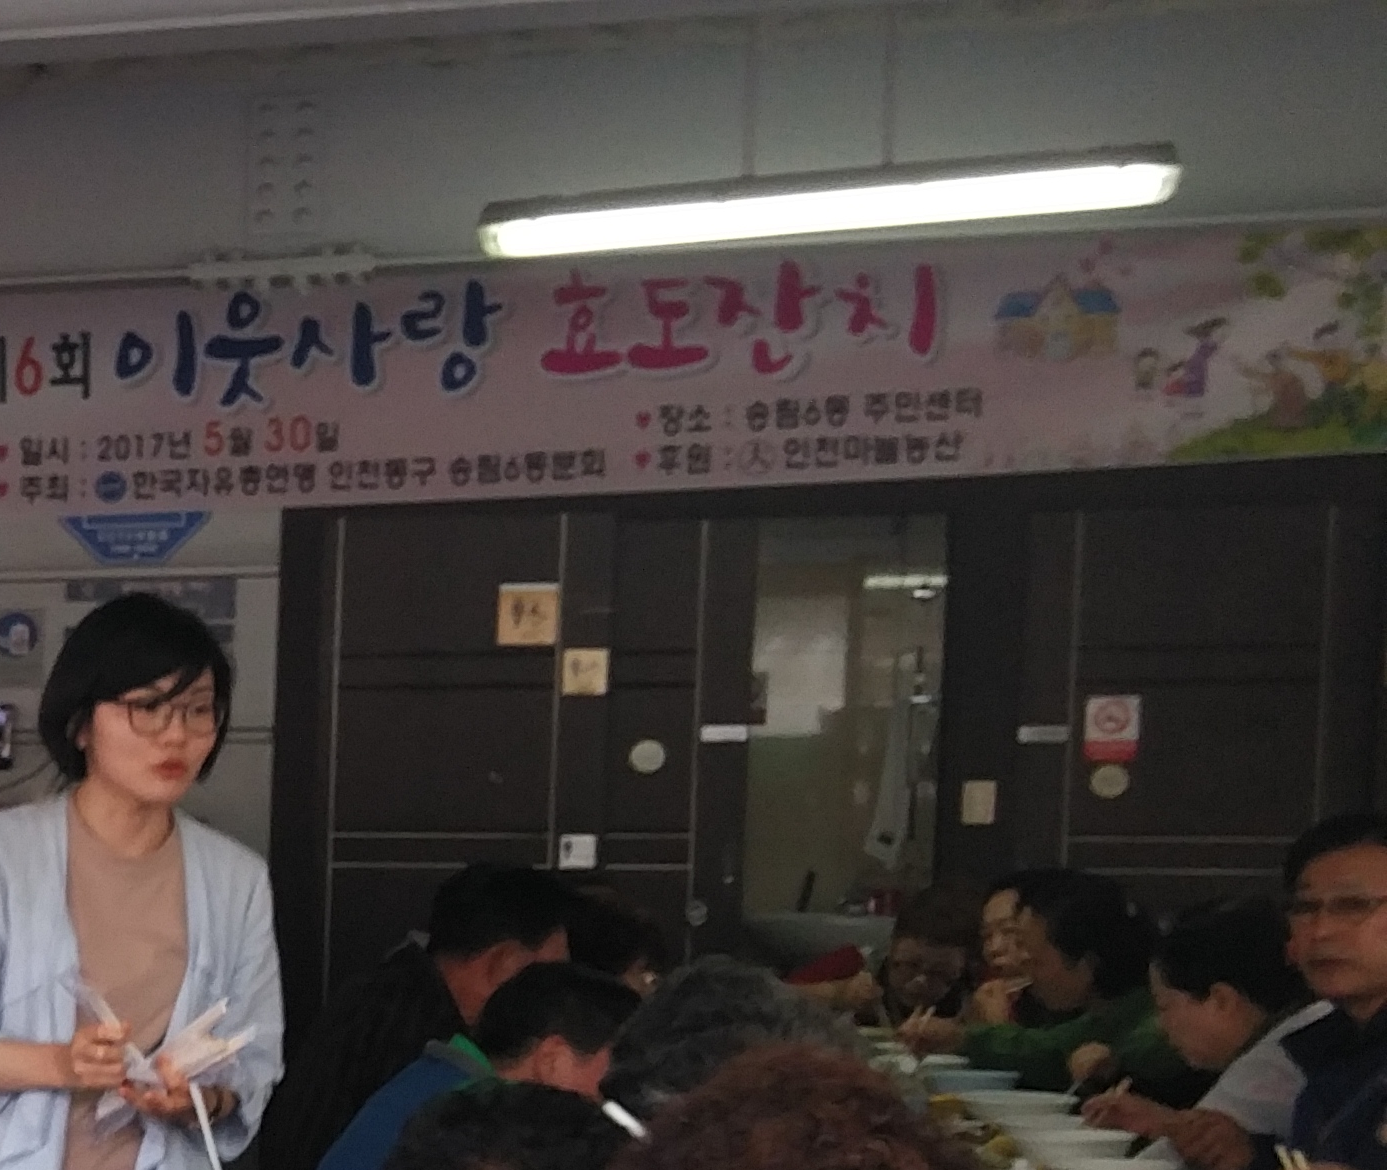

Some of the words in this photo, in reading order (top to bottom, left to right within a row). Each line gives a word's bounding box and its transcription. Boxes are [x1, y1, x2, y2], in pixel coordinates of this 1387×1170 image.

[115, 279, 503, 406] 이웃사랑
[540, 260, 940, 374] 효도잔치
[658, 402, 712, 436] 장소
[864, 387, 983, 425] 주민센터
[20, 435, 69, 466] 일시
[95, 430, 192, 462] 2017년
[203, 420, 254, 457] 5월
[264, 414, 340, 453] 30일
[20, 474, 69, 505] 주최
[132, 462, 316, 501] 한국자유총연맹
[329, 456, 437, 492] 인천동구
